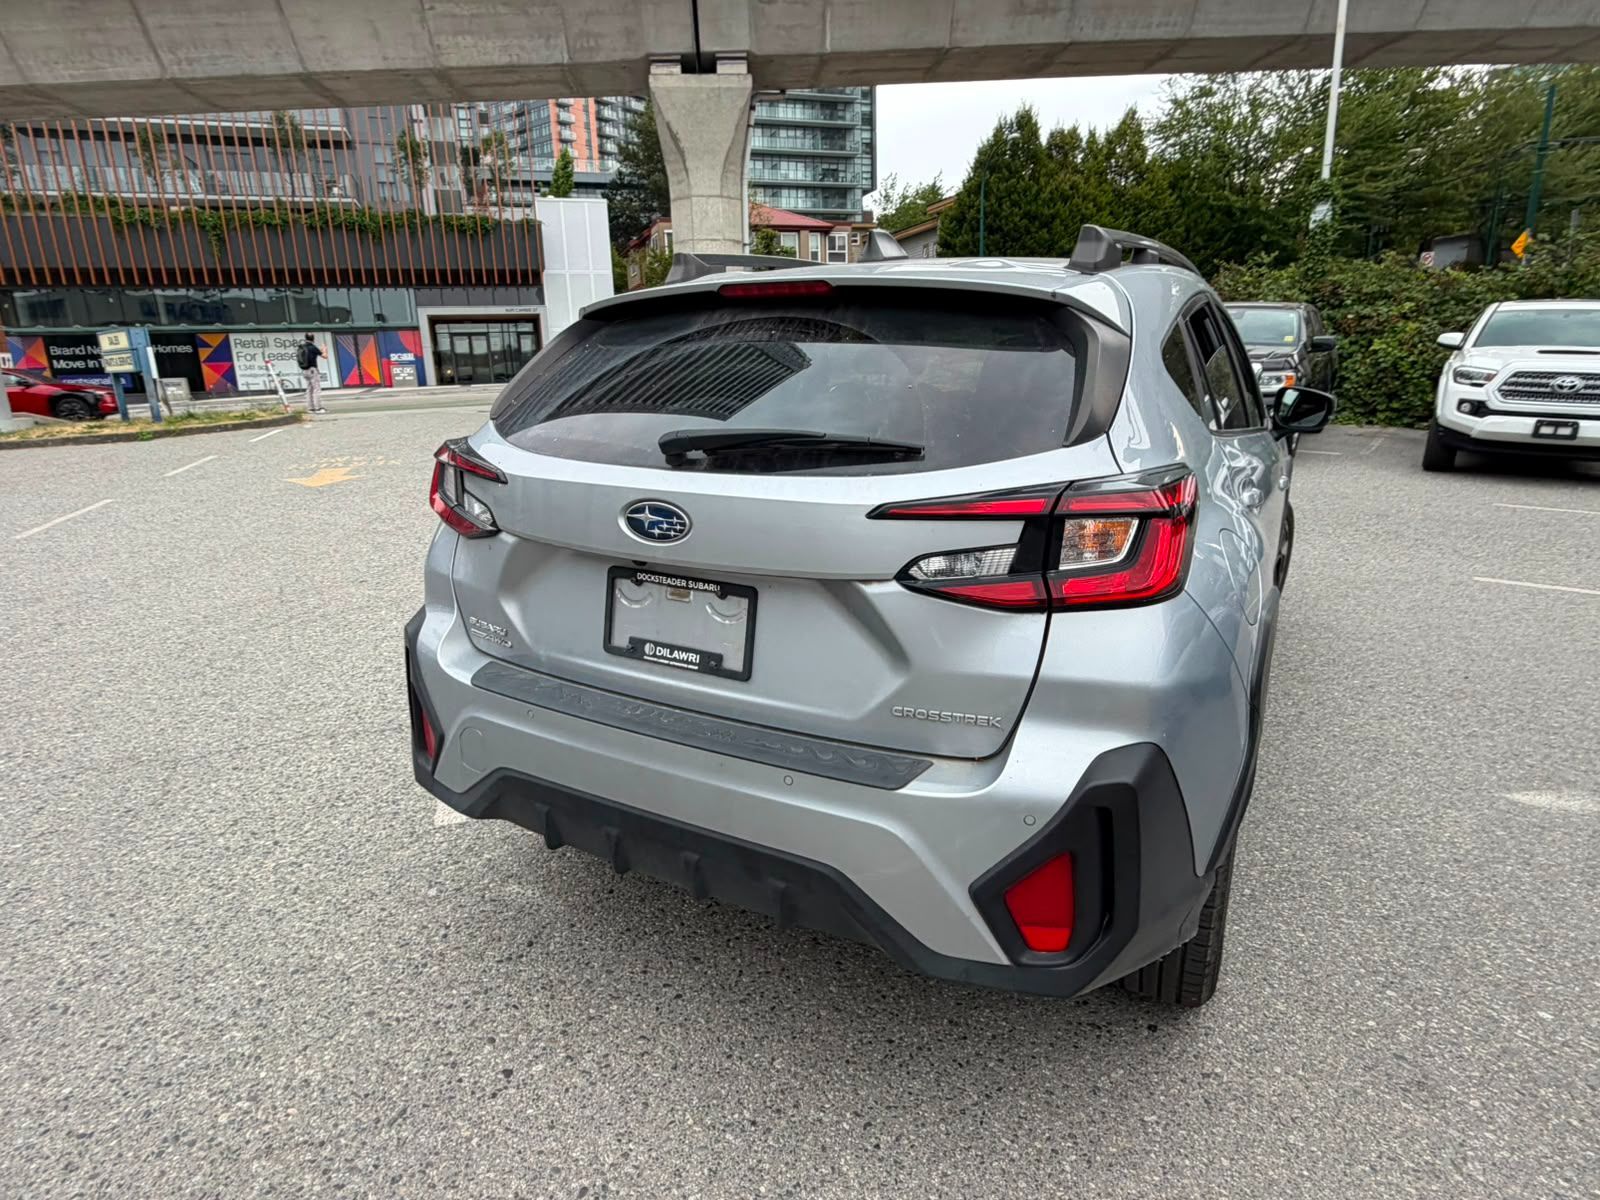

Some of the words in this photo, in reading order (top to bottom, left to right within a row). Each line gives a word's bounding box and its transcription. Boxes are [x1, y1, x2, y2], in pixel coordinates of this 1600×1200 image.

[49, 345, 85, 356] Brand
[153, 344, 193, 354] Homes
[233, 337, 269, 349] Retail
[273, 337, 304, 350] Spa
[236, 351, 257, 362] For
[262, 351, 298, 362] Lease
[53, 359, 86, 369] Move
[87, 358, 99, 369] In
[636, 572, 687, 588] DOCKSTEADER
[688, 580, 721, 592] SUBARU
[655, 647, 700, 664] DILAWRI
[892, 705, 1003, 729] CROSSTREK
